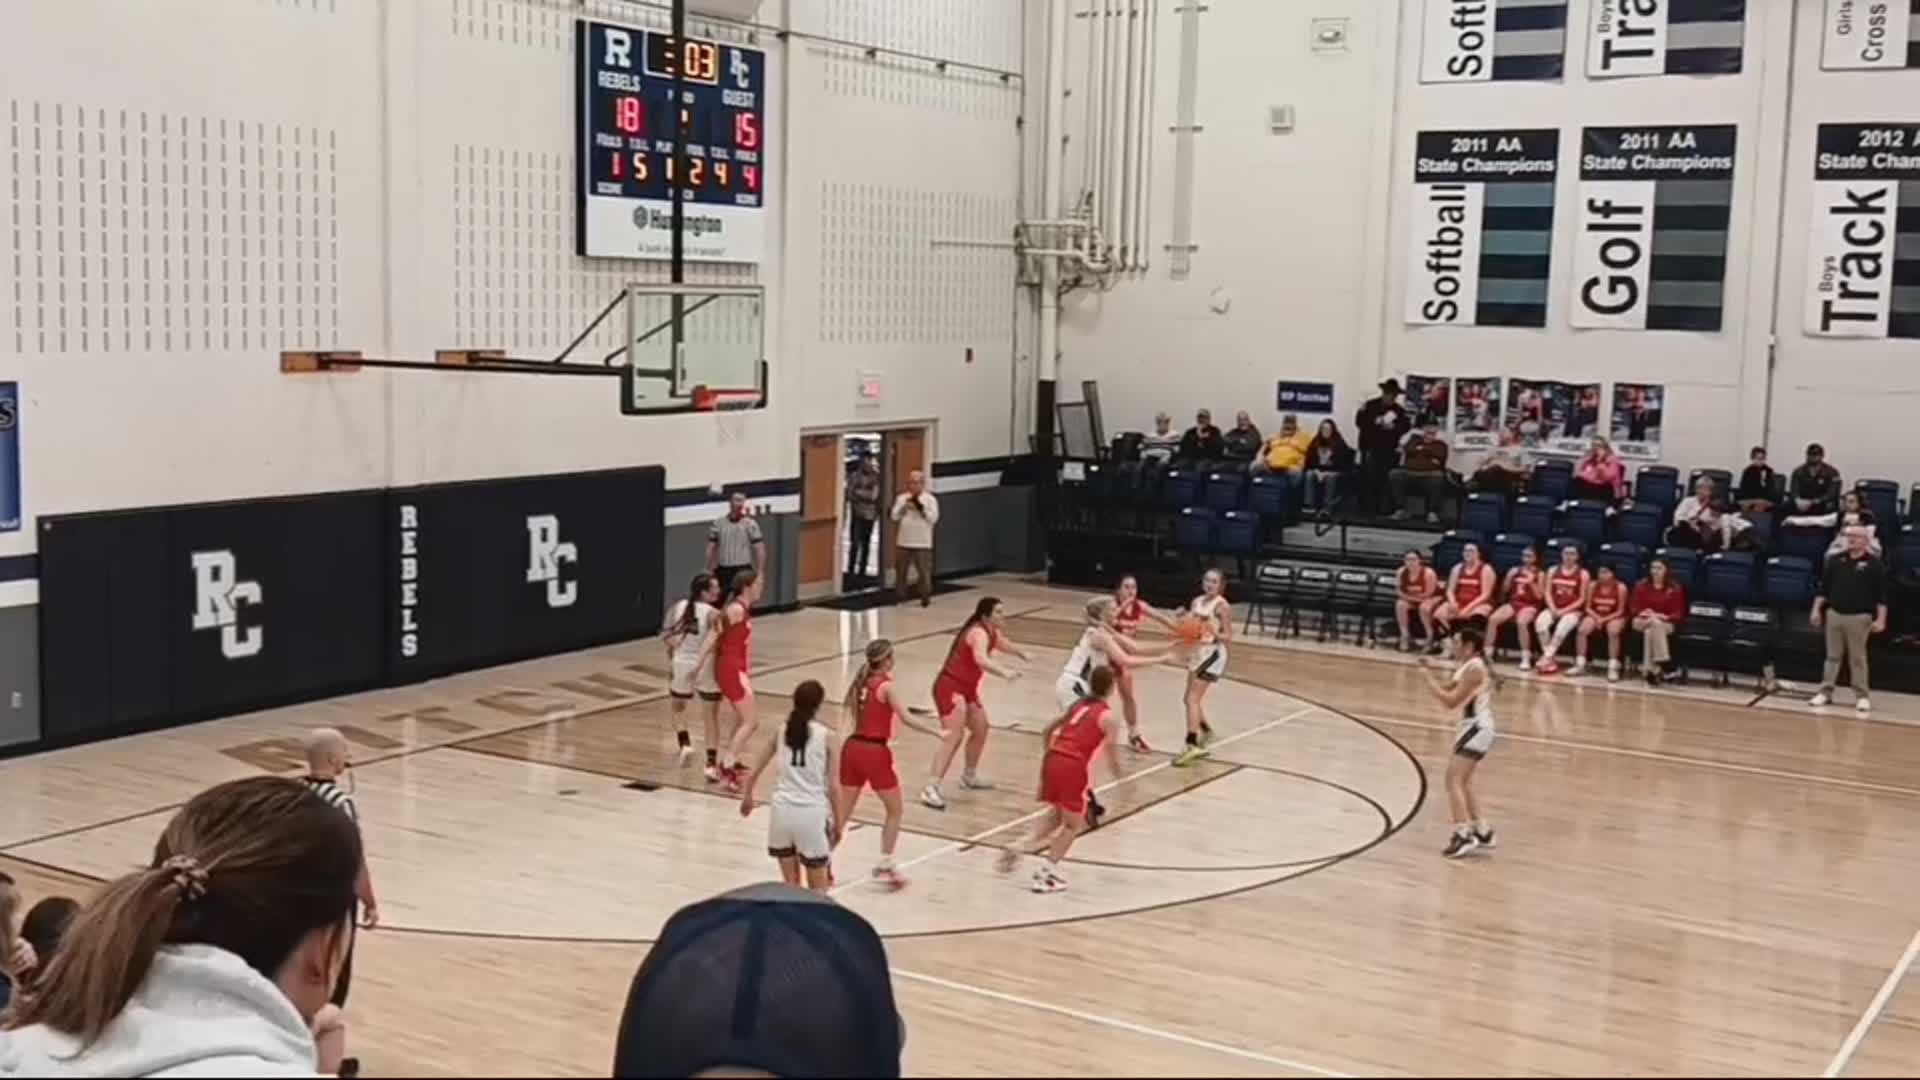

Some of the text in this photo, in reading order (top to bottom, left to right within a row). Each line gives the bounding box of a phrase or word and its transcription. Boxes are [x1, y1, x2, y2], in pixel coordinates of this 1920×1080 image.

[605, 28, 632, 67] R
[1447, 0, 1486, 76] Soft
[1861, 3, 1887, 61] Cross
[616, 97, 640, 132] 18
[735, 112, 757, 147] 15
[1451, 136, 1523, 153] 2011 AA
[1619, 132, 1697, 149] 2011 AA
[1858, 129, 1904, 147] 2012
[633, 152, 648, 180] 5
[689, 158, 704, 185] 2
[713, 162, 728, 185] 4
[743, 164, 756, 189] 4
[1417, 157, 1555, 175] State Champions
[1583, 154, 1733, 173] State Champions
[1818, 152, 1868, 169] State
[1422, 184, 1467, 322] Softball
[1581, 197, 1644, 315] Golf
[1820, 187, 1888, 332] Track
[1818, 255, 1837, 293] Boys
[527, 514, 577, 608] RC
[400, 504, 418, 657] REBELS
[192, 550, 262, 659] RC
